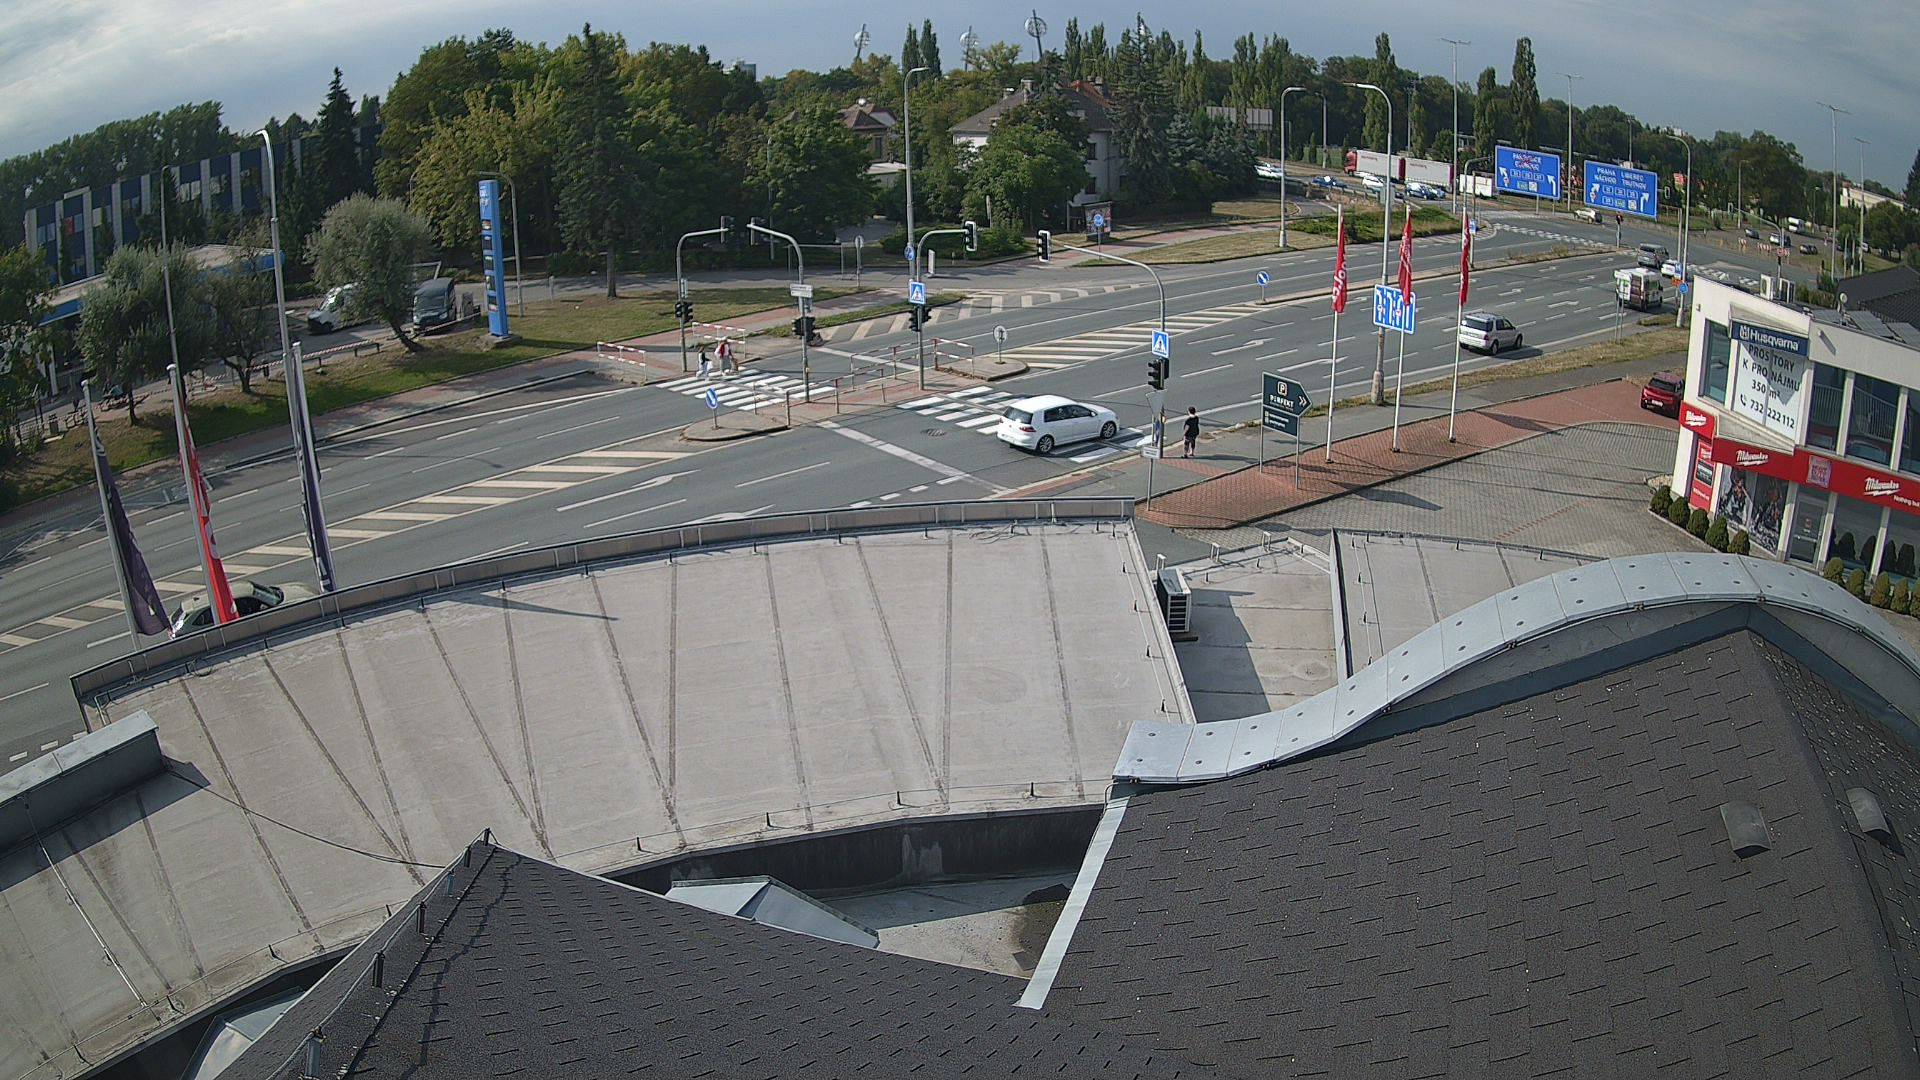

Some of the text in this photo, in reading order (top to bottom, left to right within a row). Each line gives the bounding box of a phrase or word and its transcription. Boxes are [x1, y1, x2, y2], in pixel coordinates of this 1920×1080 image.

[1750, 329, 1799, 351] Husqvarna
[1742, 358, 1748, 370] K
[1752, 380, 1766, 394] 350
[1750, 399, 1764, 414] 732
